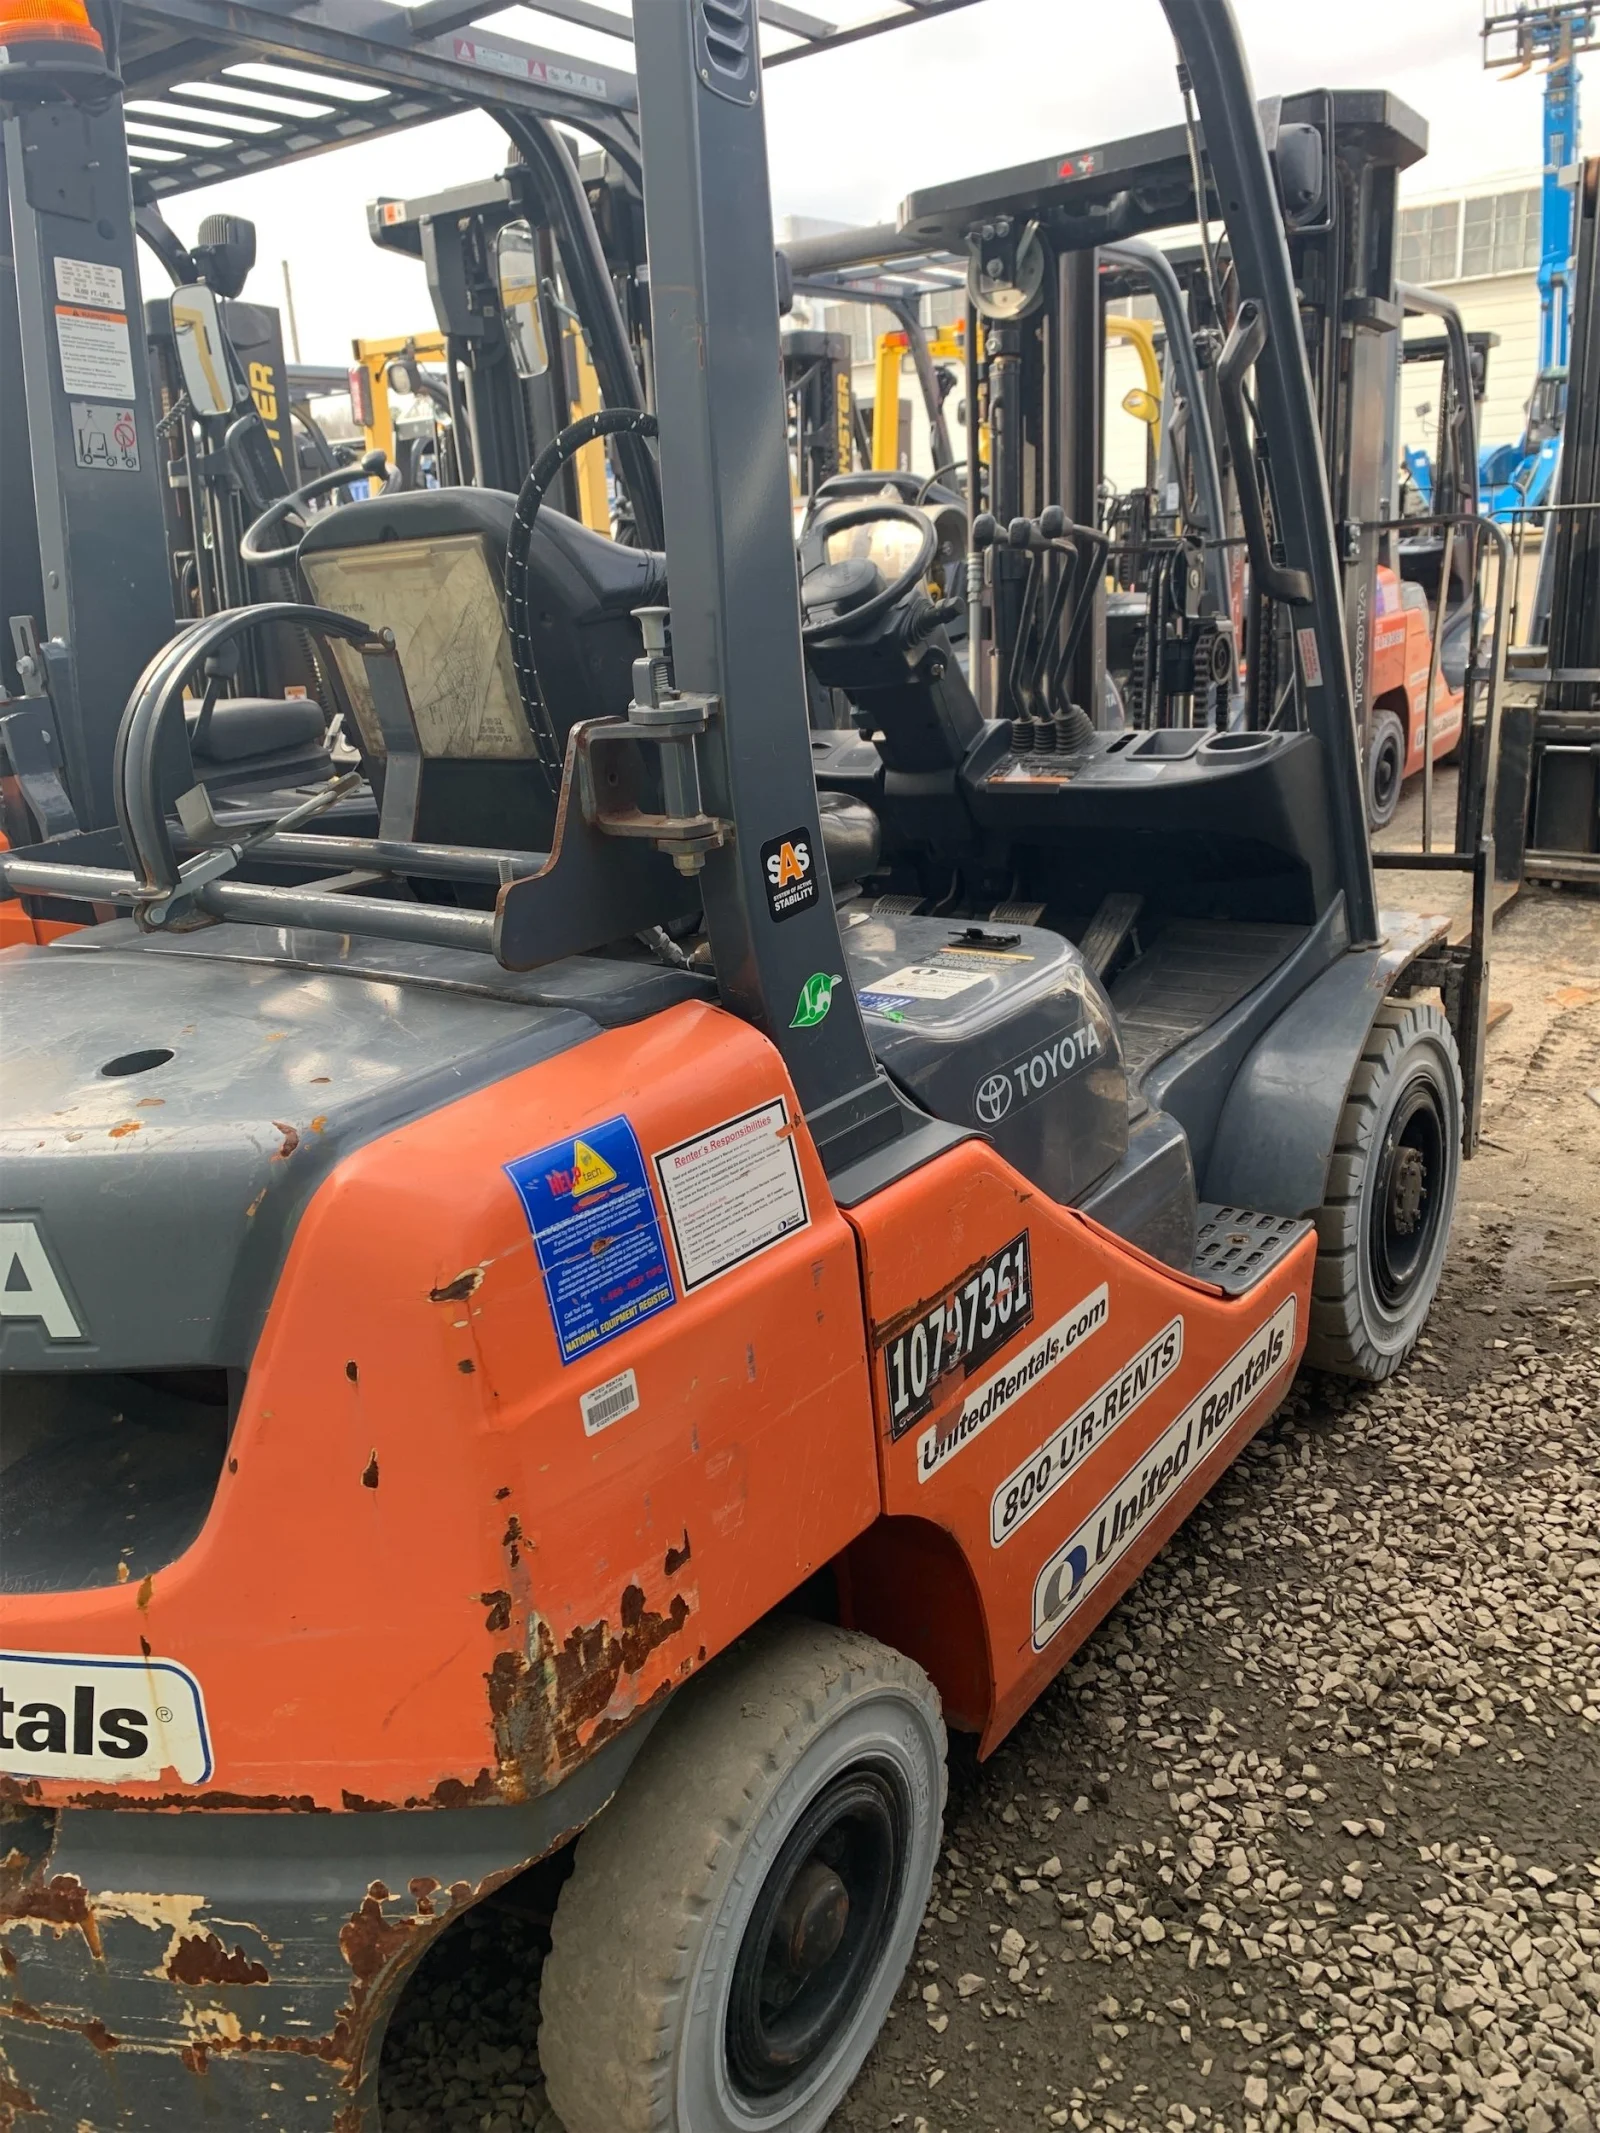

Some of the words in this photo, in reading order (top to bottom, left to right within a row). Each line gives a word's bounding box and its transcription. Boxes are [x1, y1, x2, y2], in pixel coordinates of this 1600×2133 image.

[1354, 585, 1368, 708] TOYOTA
[767, 841, 810, 888] SAS
[773, 889, 791, 901] SYSTEM
[790, 886, 797, 894] OF
[797, 880, 812, 890] ACTIVE
[775, 886, 813, 912] STABILITY
[1014, 1022, 1101, 1097] TOYOTA
[673, 1143, 708, 1168] Renter's
[709, 1113, 772, 1153] Responsibilities
[546, 1163, 584, 1197] HELP
[711, 1254, 725, 1267] Thank
[724, 1249, 734, 1259] You
[741, 1239, 751, 1250] Your
[751, 1227, 772, 1244] Business!
[564, 1325, 600, 1353] NATIONAL
[599, 1304, 639, 1334] EQUIPMENT
[637, 1286, 670, 1313] REGISTER
[893, 1240, 1030, 1417] 10797361
[587, 1387, 605, 1399] UNITED
[606, 1374, 627, 1388] RENTALS
[1002, 1332, 1176, 1527] 800-UR-RENTS
[1096, 1418, 1193, 1565] United
[1197, 1328, 1285, 1450] Rentals
